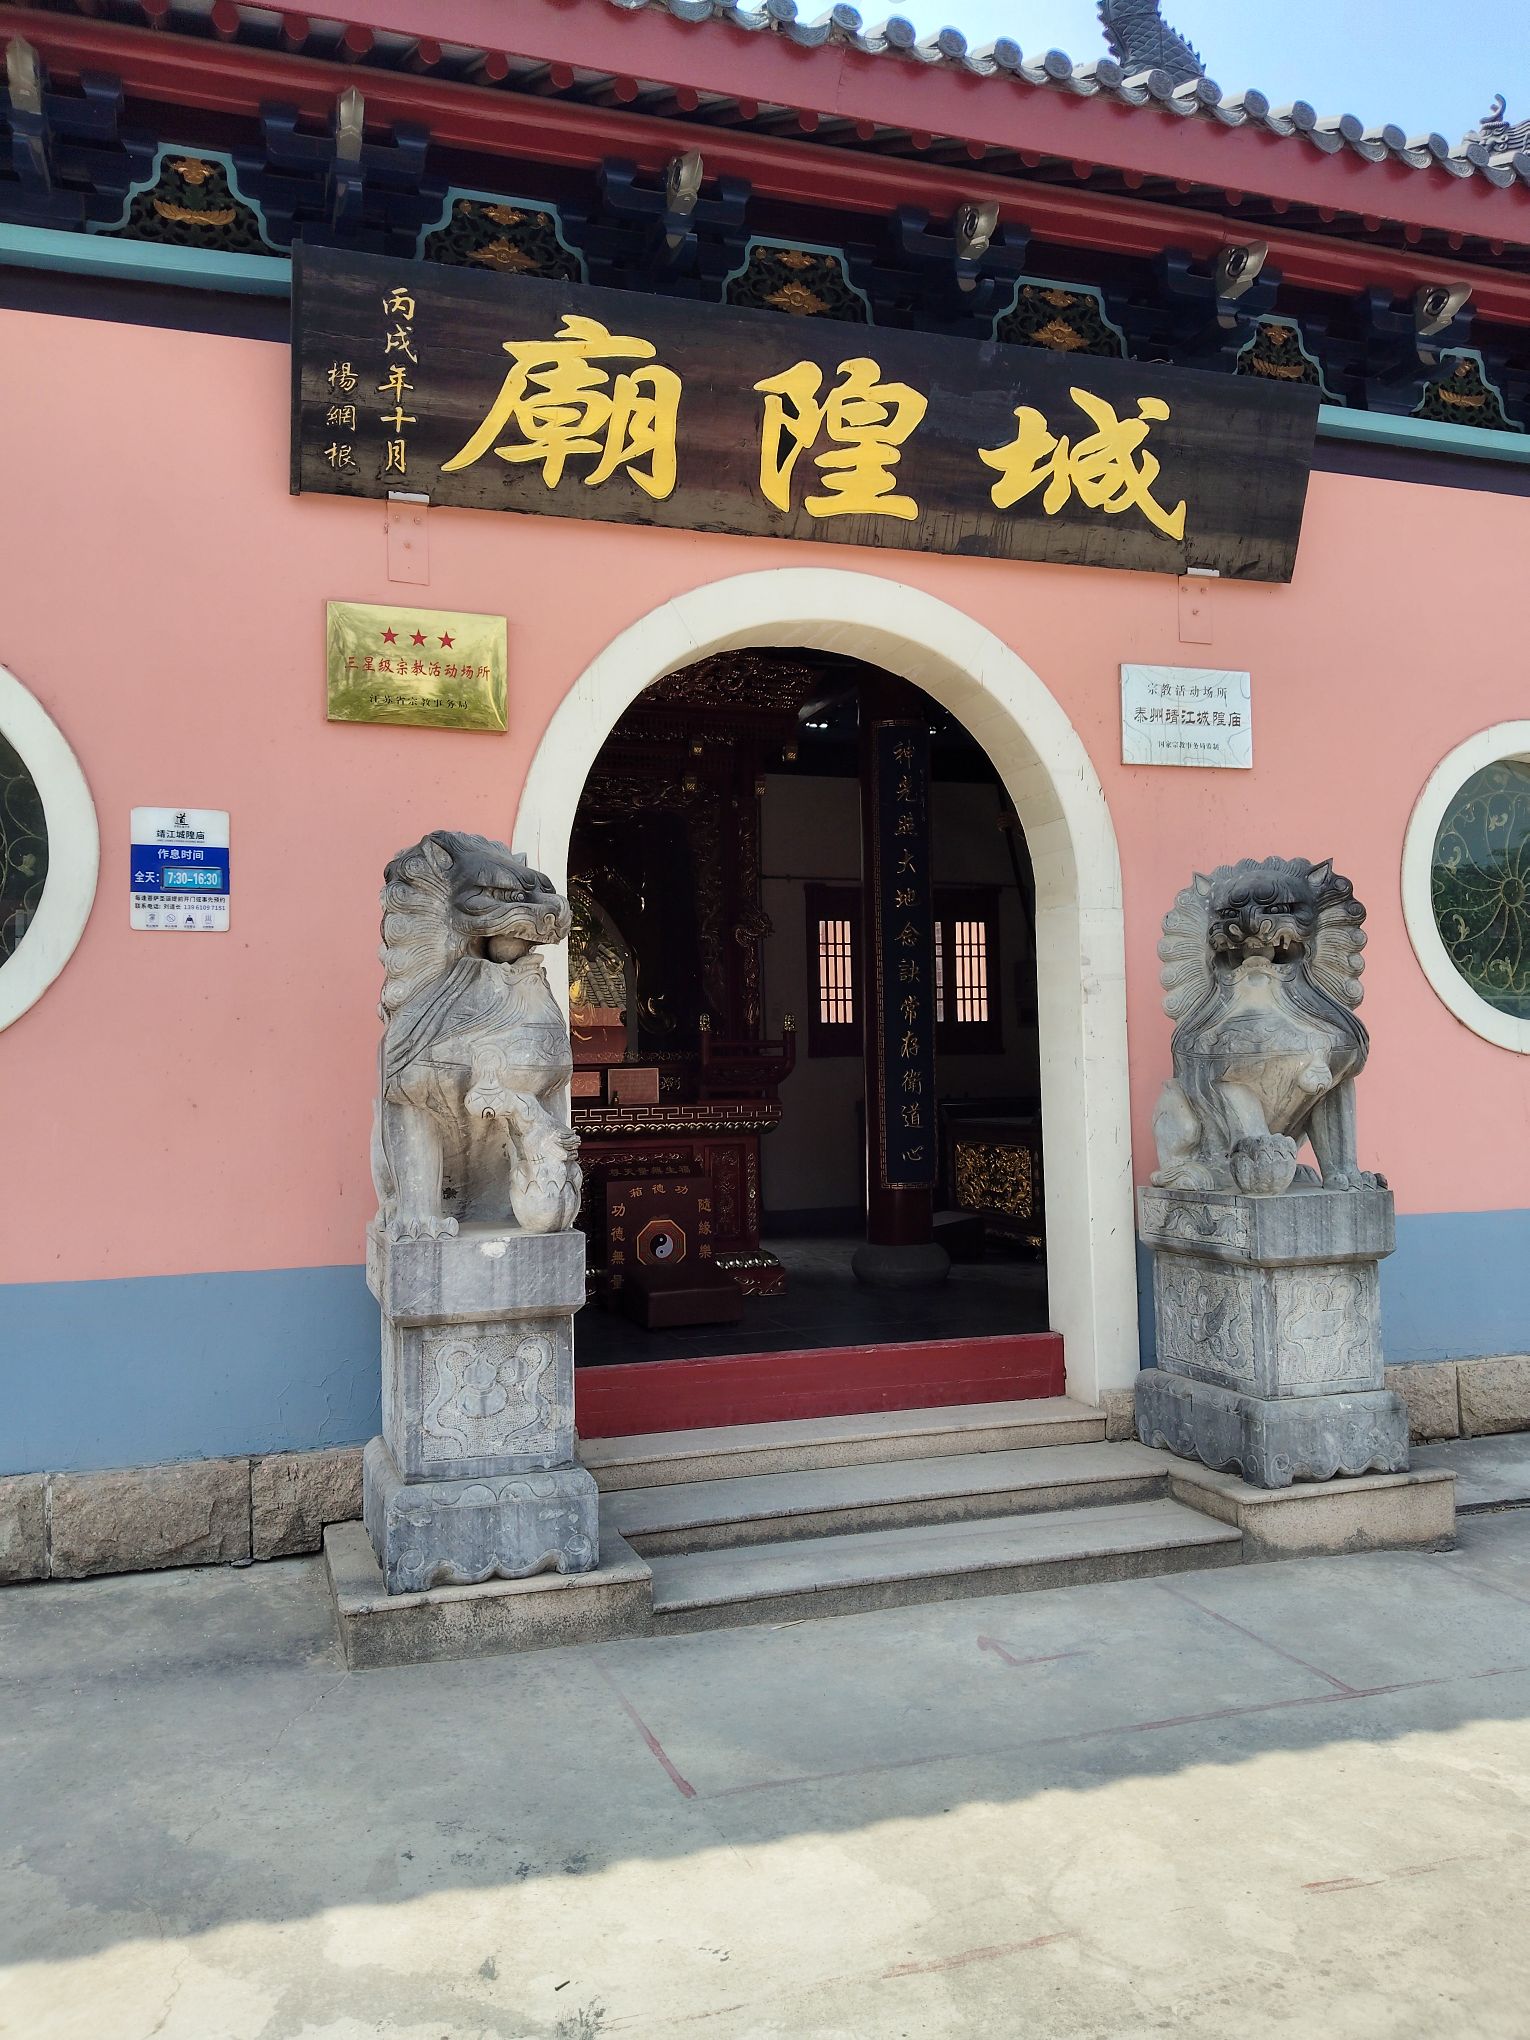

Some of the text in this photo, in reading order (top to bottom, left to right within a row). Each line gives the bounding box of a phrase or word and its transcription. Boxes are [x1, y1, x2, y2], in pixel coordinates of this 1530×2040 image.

[377, 287, 418, 474] 丙戌年十月
[344, 656, 491, 682] 三星级宗教活动场所
[1147, 682, 1228, 699] 宗教活动场所
[369, 693, 468, 710] 江苏省宗教事务局
[1134, 706, 1241, 727] 泰州靖江城隍庙
[156, 829, 205, 840] 靖江城隍庙
[157, 848, 204, 860] 作息时间
[167, 872, 218, 885] 7:30-16:30
